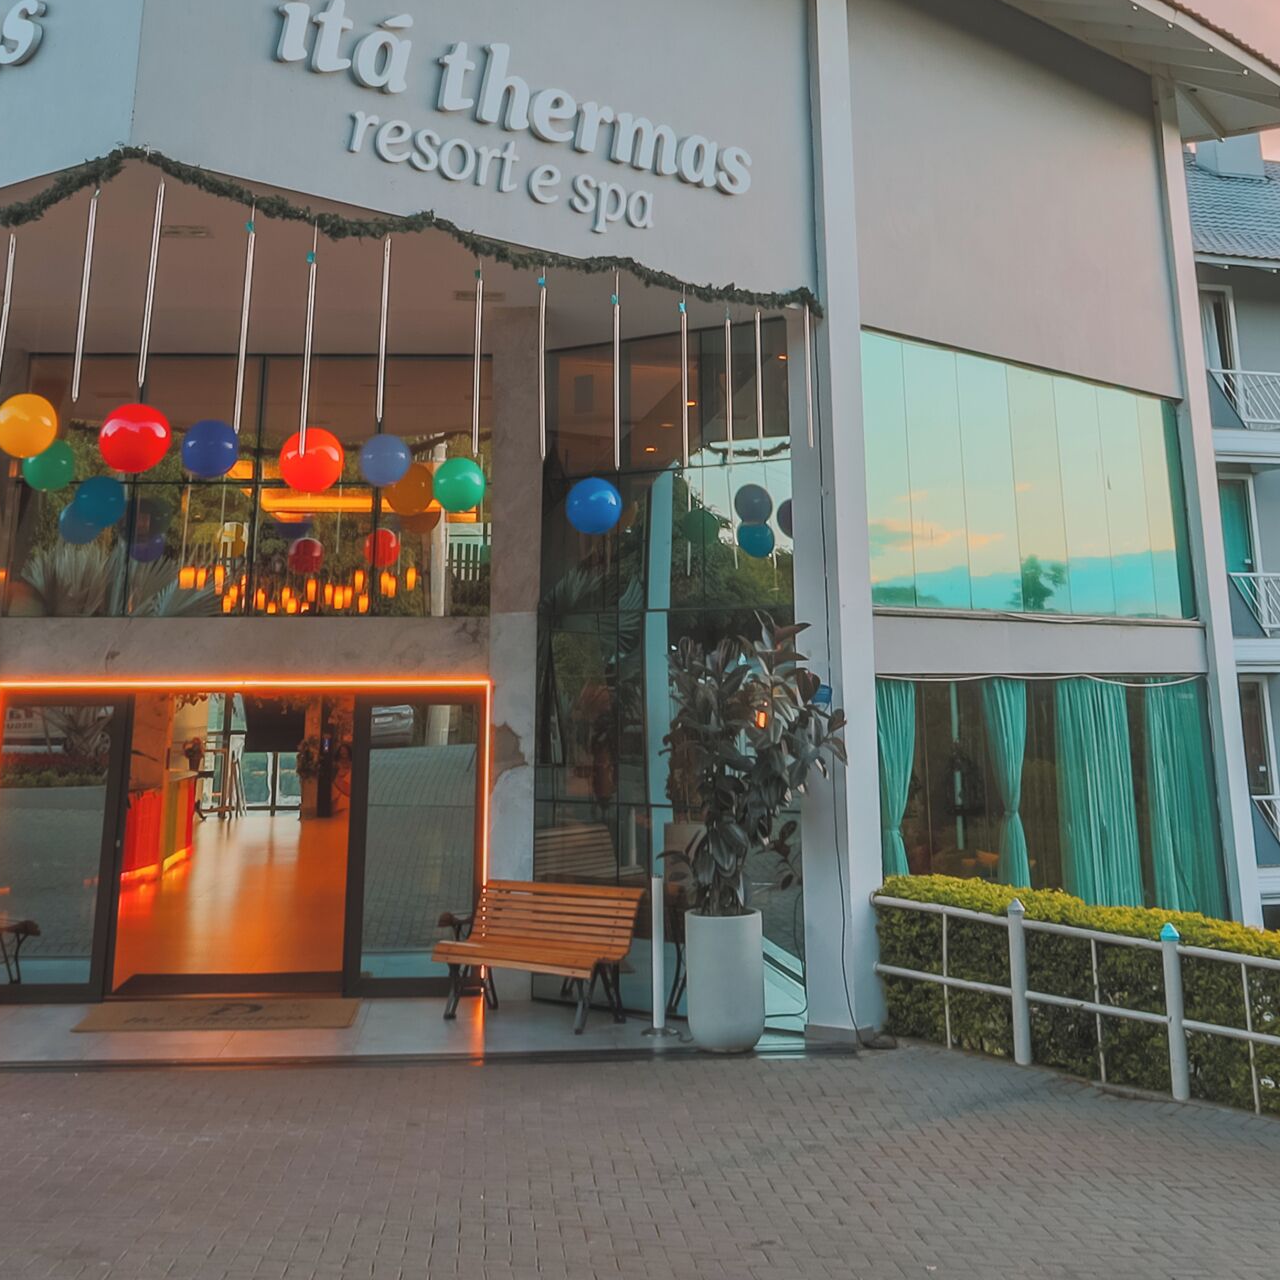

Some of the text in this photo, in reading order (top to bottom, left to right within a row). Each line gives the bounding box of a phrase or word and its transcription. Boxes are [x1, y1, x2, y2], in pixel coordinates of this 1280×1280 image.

[348, 111, 655, 234] resort e spa
[436, 41, 753, 195] thermas
